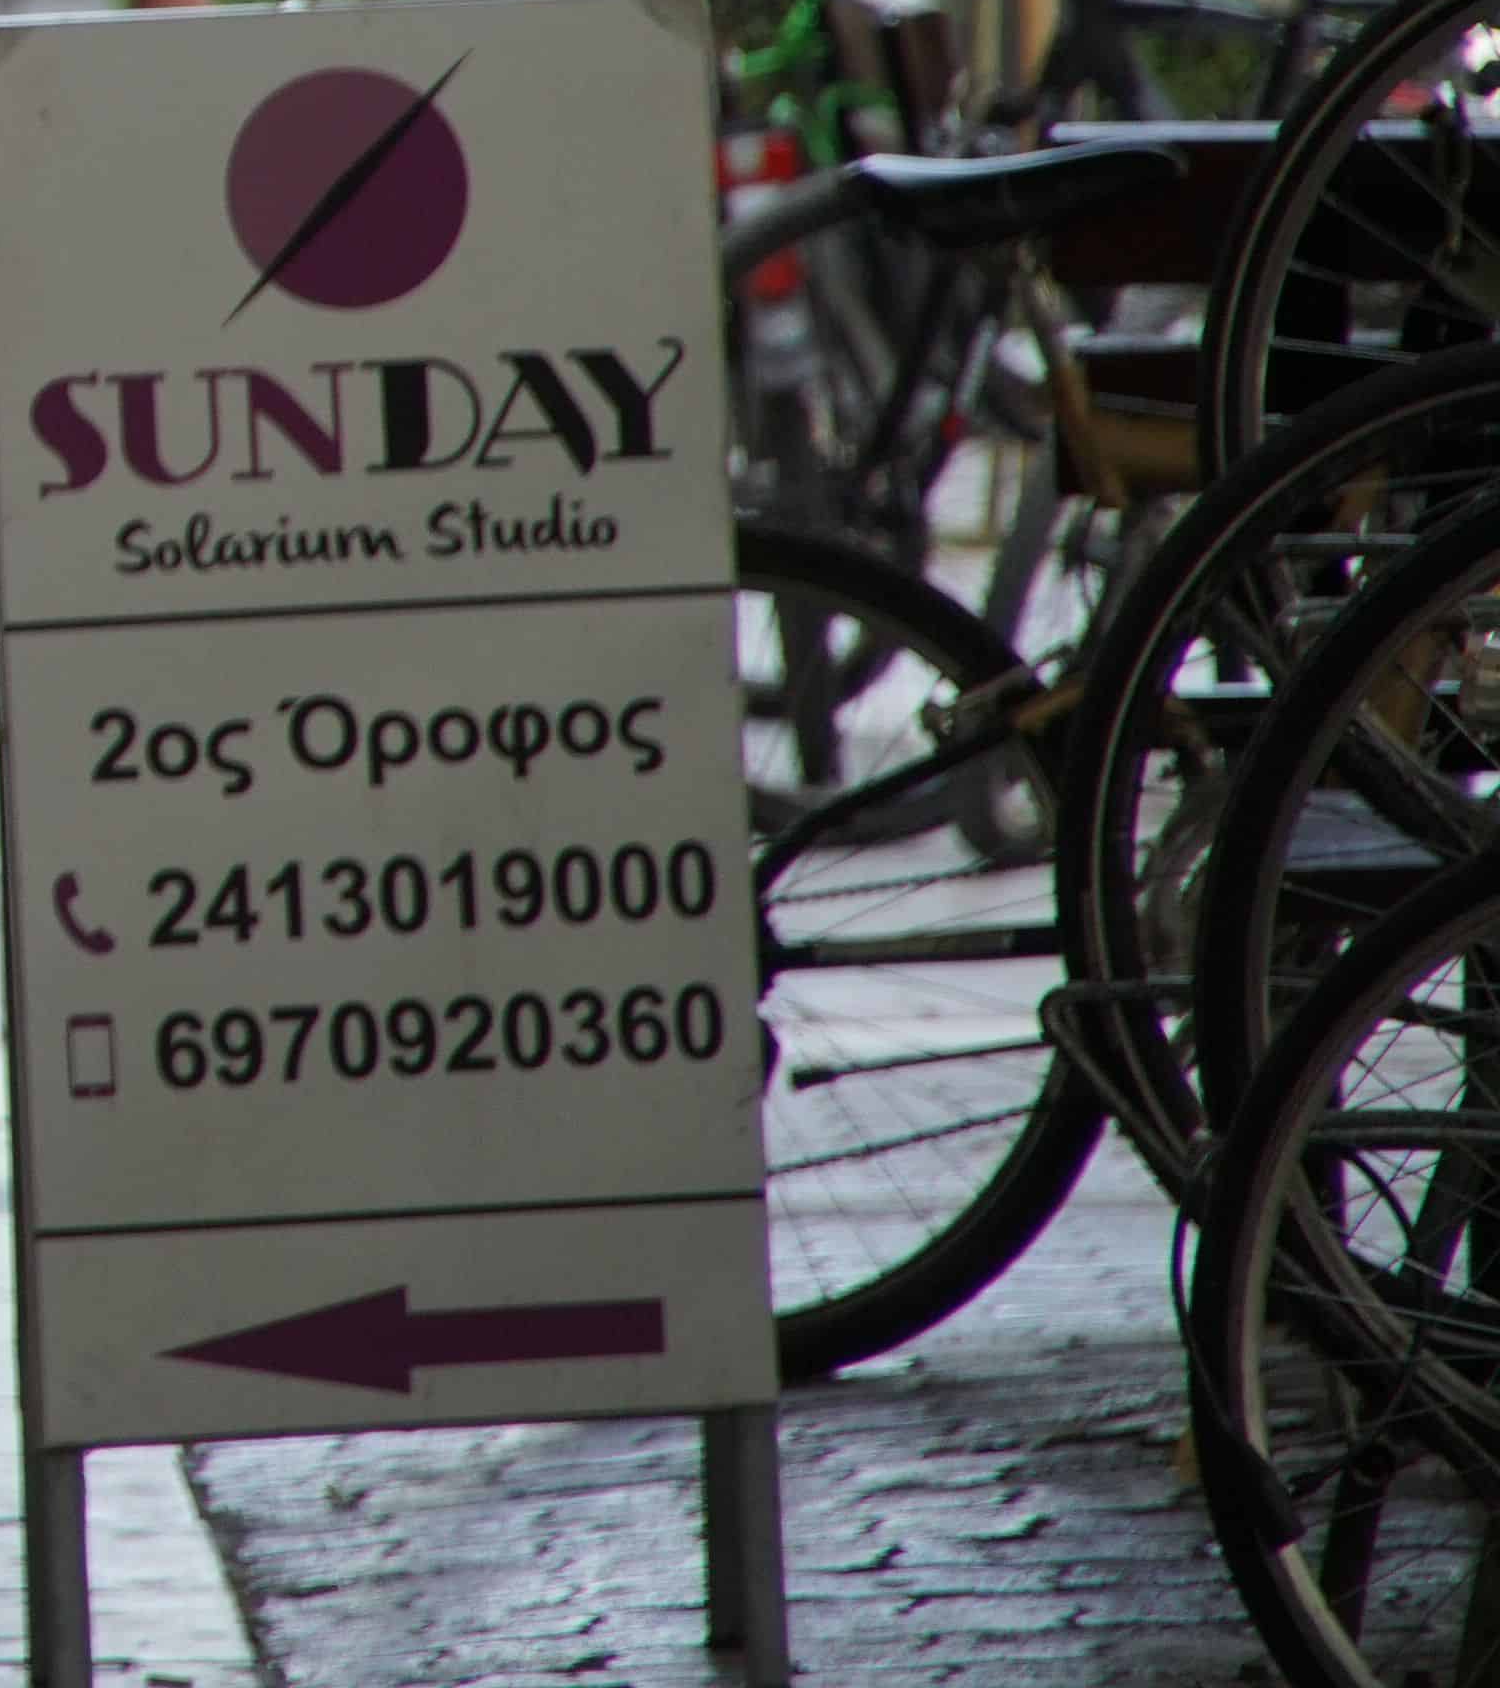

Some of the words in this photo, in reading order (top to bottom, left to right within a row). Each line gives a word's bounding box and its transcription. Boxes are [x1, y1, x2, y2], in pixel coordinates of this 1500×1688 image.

[30, 337, 684, 499] SUNDAY
[116, 514, 401, 575] Solarium
[426, 494, 618, 558] Studio
[90, 707, 253, 797] 2ος
[277, 693, 665, 787] Όροφος
[148, 838, 717, 948] 2413019000
[156, 982, 725, 1089] 6970920360
